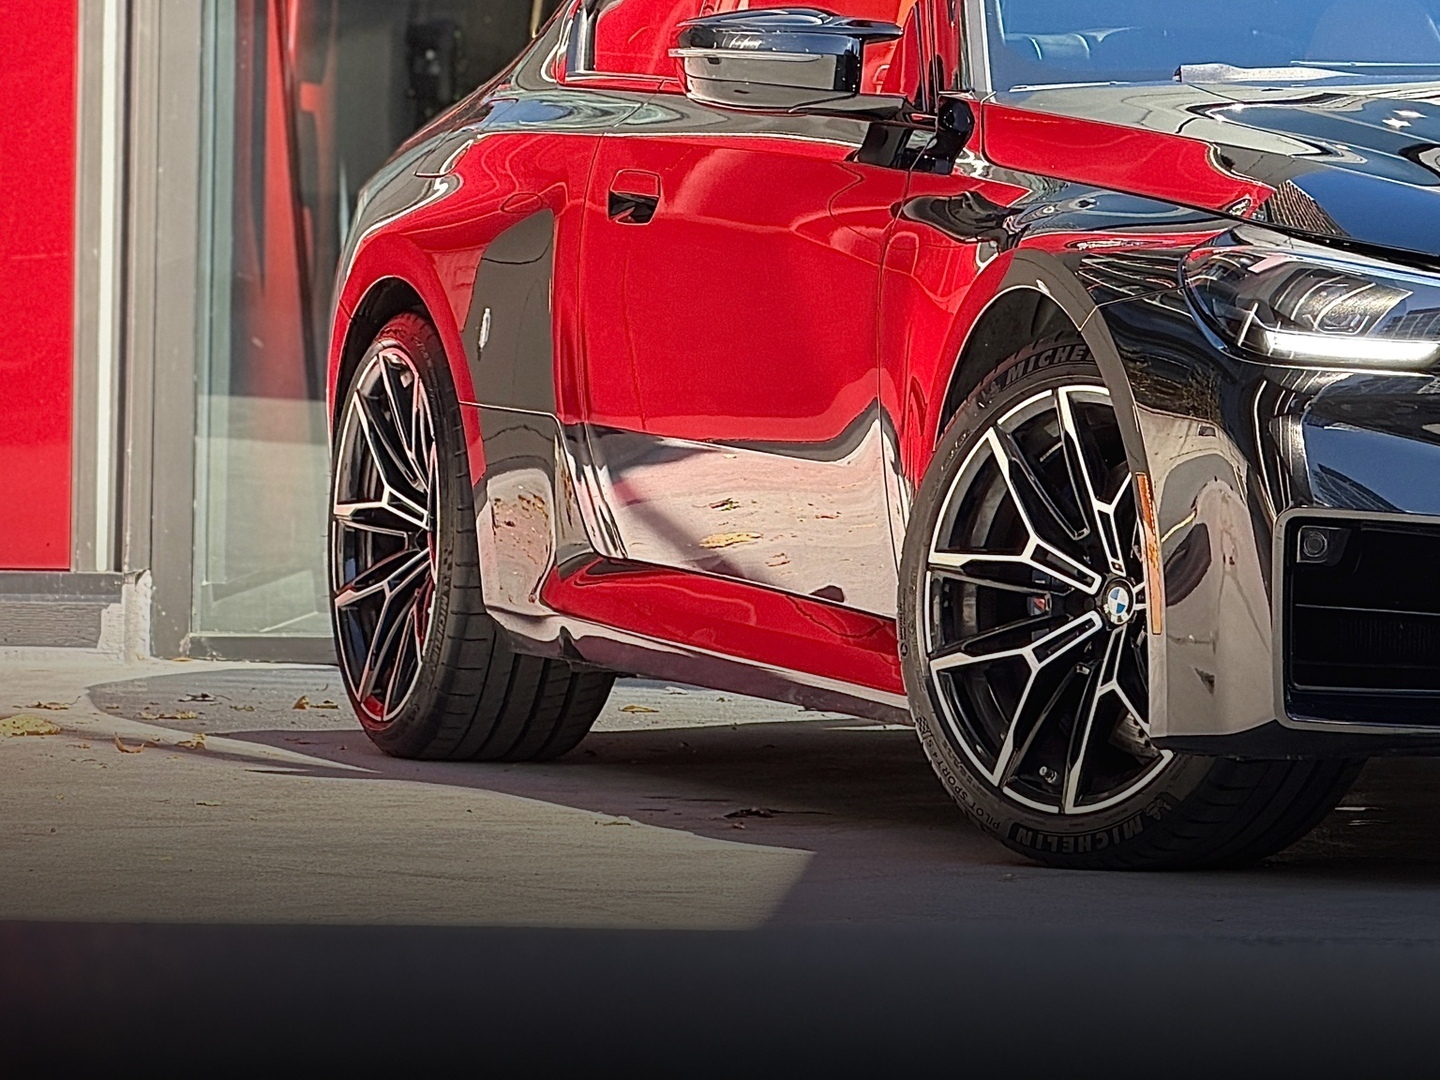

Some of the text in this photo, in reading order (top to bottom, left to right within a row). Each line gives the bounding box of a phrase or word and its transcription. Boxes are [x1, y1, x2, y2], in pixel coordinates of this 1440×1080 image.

[1005, 345, 1095, 386] MICHE
[936, 760, 968, 801] SPORT
[969, 801, 1001, 830] PILOT
[1016, 815, 1143, 853] MICHELIN
